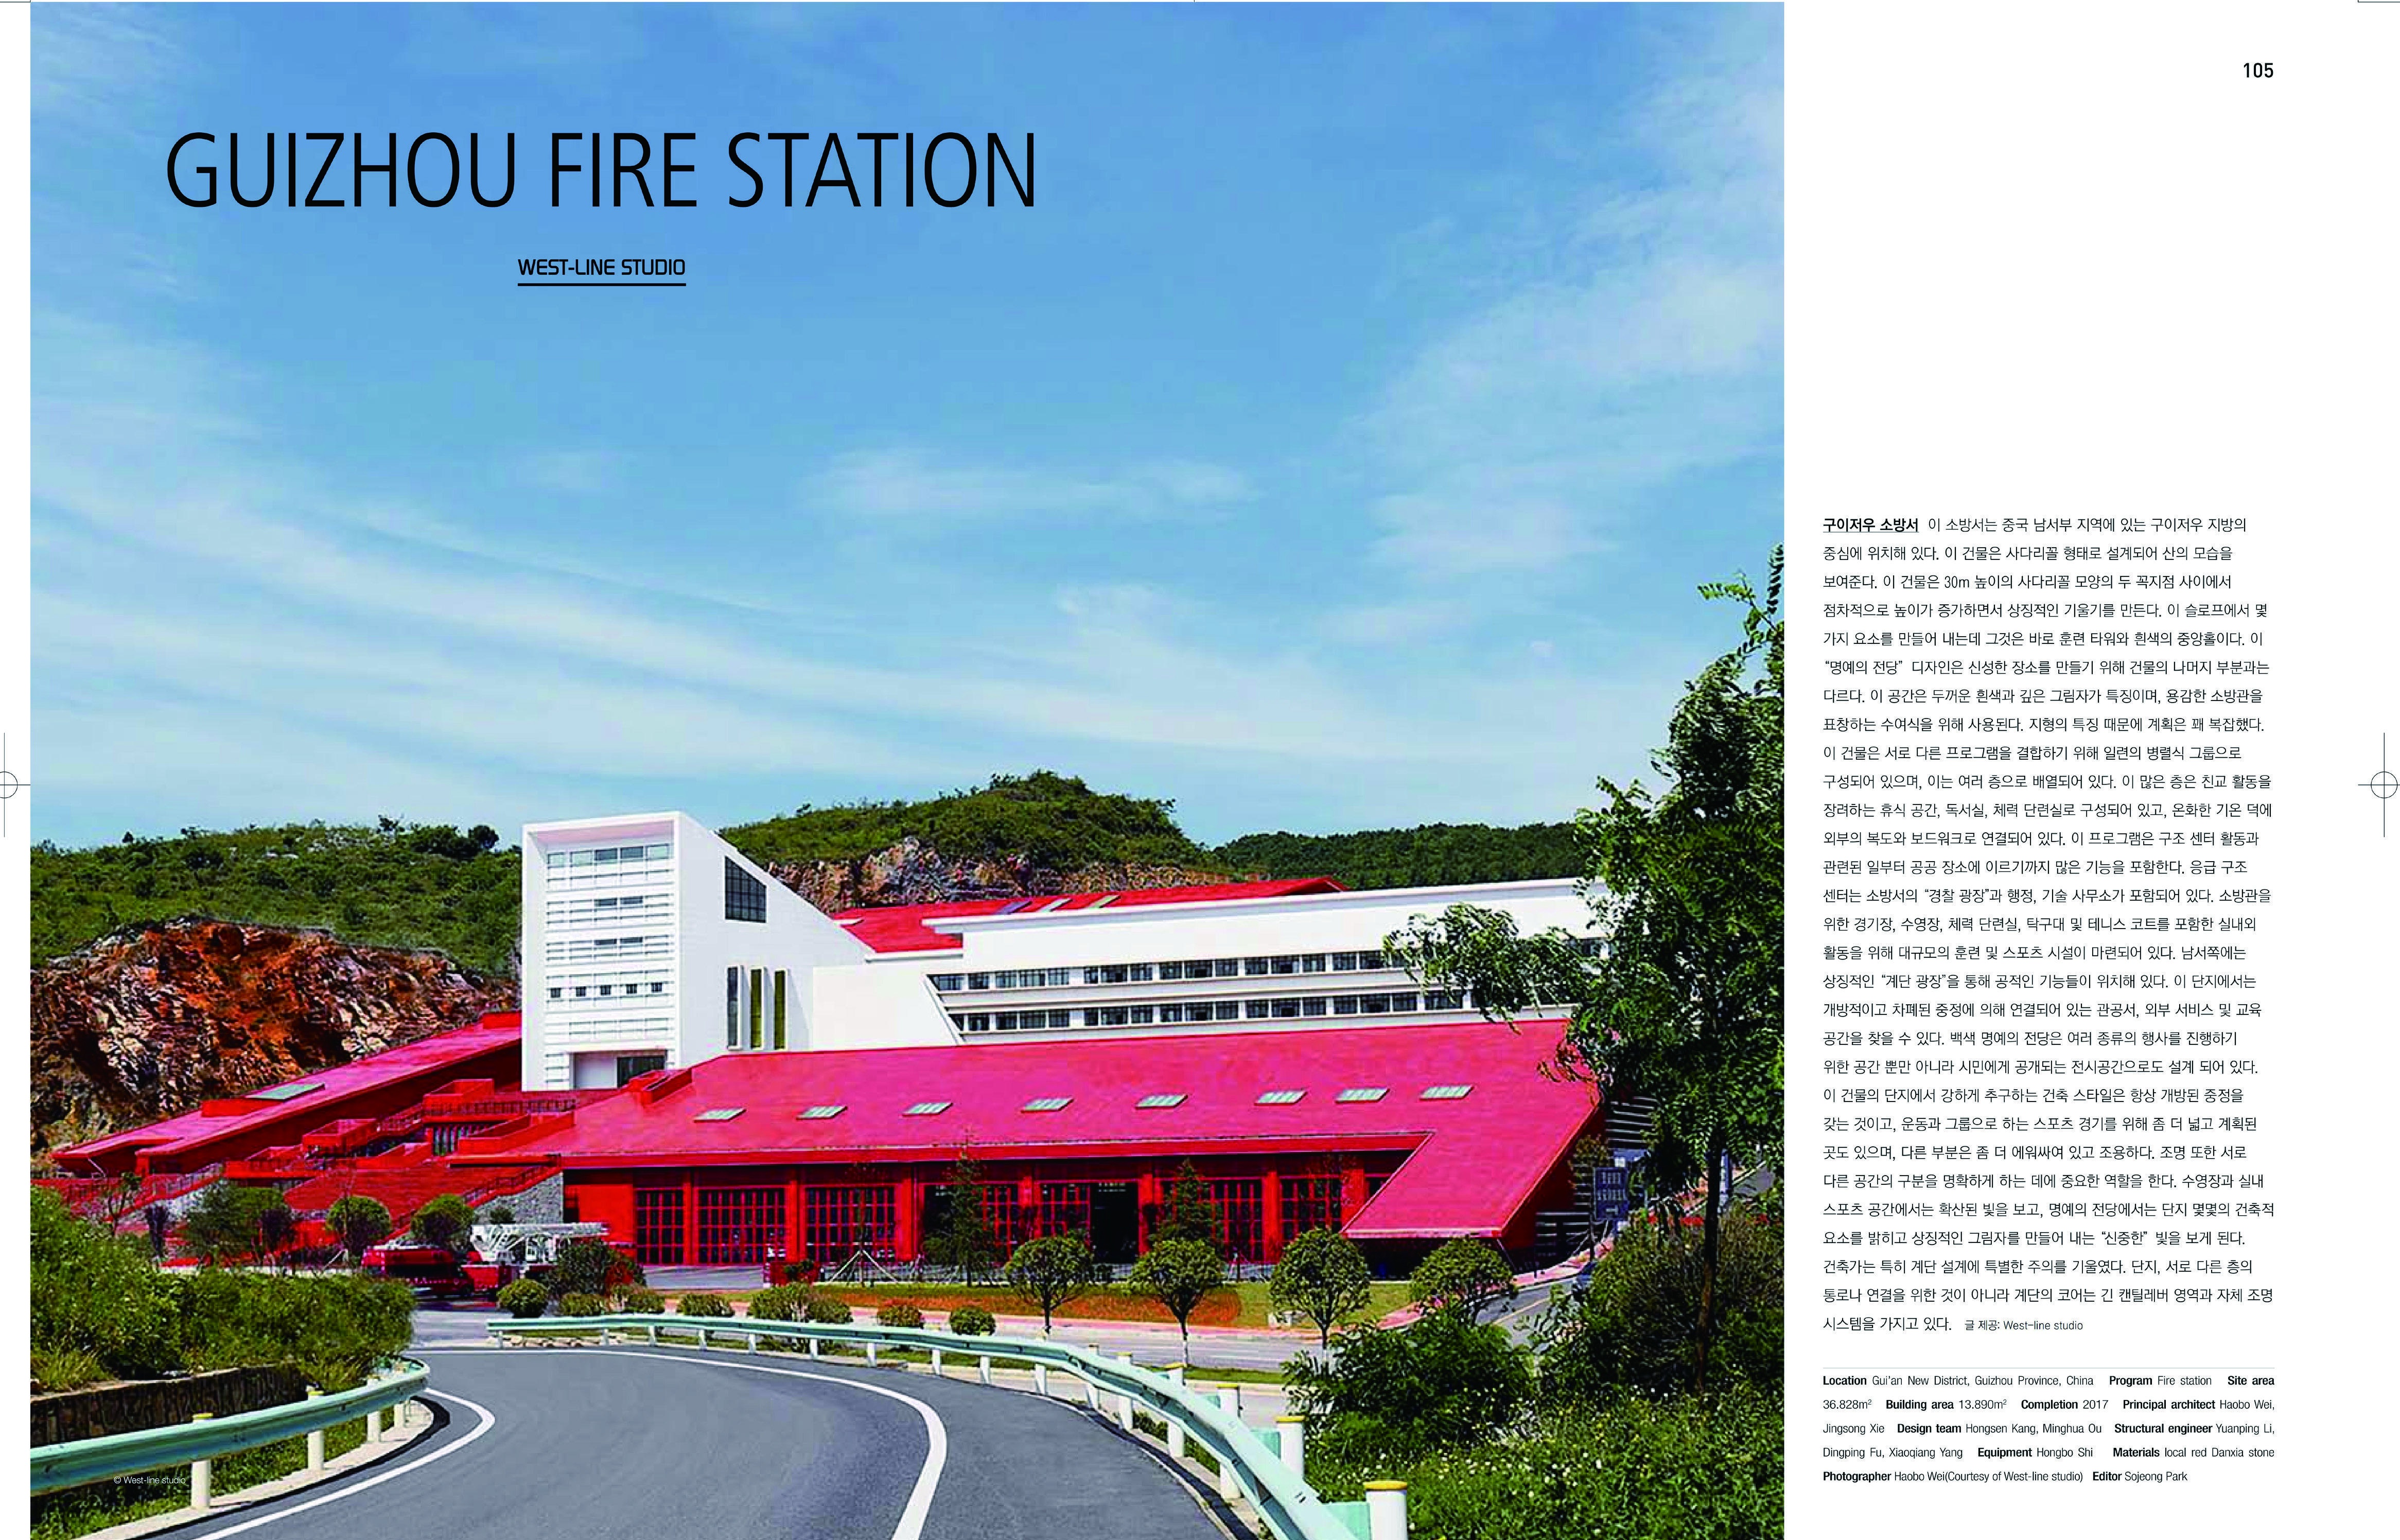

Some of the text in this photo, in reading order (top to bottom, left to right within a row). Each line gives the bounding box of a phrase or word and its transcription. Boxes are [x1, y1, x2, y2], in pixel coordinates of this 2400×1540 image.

[2244, 62, 2273, 78] 105
[1823, 518, 2246, 532] 구이저우 소방서 이 소방서는 중국 남서부 지역에 있는 구이저우 지방의
[1823, 603, 2267, 618] 점차적으로 높이가 증가하면서 상징적인 기울기를 만든다. 이 슬로프에서 몇
[1824, 689, 2263, 705] 다르다. 이 공간은 두꺼운 흰색과 깊은 그림자가 특징이며, 용감한 소방관을
[1824, 746, 2241, 761] 이 건물은 서로 다른 프로그램을 결합하기 위해 일련의 병렬식 그룹으로
[1823, 860, 2248, 874] 관련된 일부터 공공 장소에 이르기까지 많은 기능을 포함한다. 응급 구조
[1823, 974, 1874, 989] 상징적인
[1964, 974, 1990, 989] 통해
[1995, 974, 2034, 989] 공적인
[2040, 974, 2091, 989] 기능들이
[2097, 974, 2135, 989] 위치해
[2141, 974, 2168, 989] 있다.
[2174, 974, 2185, 989] 이
[2192, 974, 2256, 989] 단지에서는
[1824, 1089, 2244, 1103] 이 건물의 단지에서 강하게 추구하는 건축 스타일은 항상 개방된 중정을
[1823, 1232, 1863, 1245] 요소를
[1868, 1231, 1907, 1246] 밝히고
[1912, 1231, 1963, 1246] 상징적인
[1968, 1231, 2020, 1246] 그림자를
[2025, 1231, 2063, 1246] 만들어
[2070, 1231, 2095, 1246] 내는
[2156, 1231, 2181, 1245] 빛을
[2185, 1231, 2211, 1246] 보게
[2217, 1231, 2245, 1246] 된다.
[1823, 1317, 1952, 1331] 시스템을 가지고 있다.
[1965, 1320, 1975, 1331] 글
[1978, 1320, 2000, 1331] 제공:
[2054, 1320, 2083, 1330] studio
[1823, 1375, 1867, 1386] Location
[1908, 1375, 1929, 1386] New
[1934, 1375, 1970, 1387] District,
[1975, 1375, 2013, 1386] Guizhou
[2018, 1375, 2061, 1387] Province,
[2066, 1375, 2094, 1386] China
[2109, 1375, 2152, 1388] Program
[2158, 1375, 2175, 1386] Fire
[2180, 1375, 2212, 1386] station
[2228, 1375, 2247, 1386] Site
[2252, 1377, 2275, 1386] area
[1886, 1399, 1927, 1411] Building
[2021, 1399, 2078, 1411] Completion
[2083, 1399, 2109, 1409] 2017
[2123, 1399, 2166, 1411] Principal
[2171, 1399, 2216, 1409] architect
[2220, 1399, 2250, 1409] Haobo
[2254, 1399, 2274, 1411] Wei,
[1823, 1423, 2274, 1436] Jingsong Xie Design team Hongsen Kang, Minghua Ou Structural engineer Yuanping Li,
[1823, 1447, 2274, 1459] Dingping Fu, Xiaoqiang Yang Equipment Hongbo Shi Materials local red Danxia stone
[1823, 1471, 1892, 1483] Photographer
[1895, 1471, 1924, 1481] Haobo
[1992, 1471, 2002, 1481] of
[2004, 1471, 2048, 1481] West-line
[2052, 1471, 2083, 1483] studio)
[2093, 1471, 2123, 1481] Editor
[2125, 1471, 2163, 1483] Sojeong
[2166, 1471, 2188, 1481] Park
